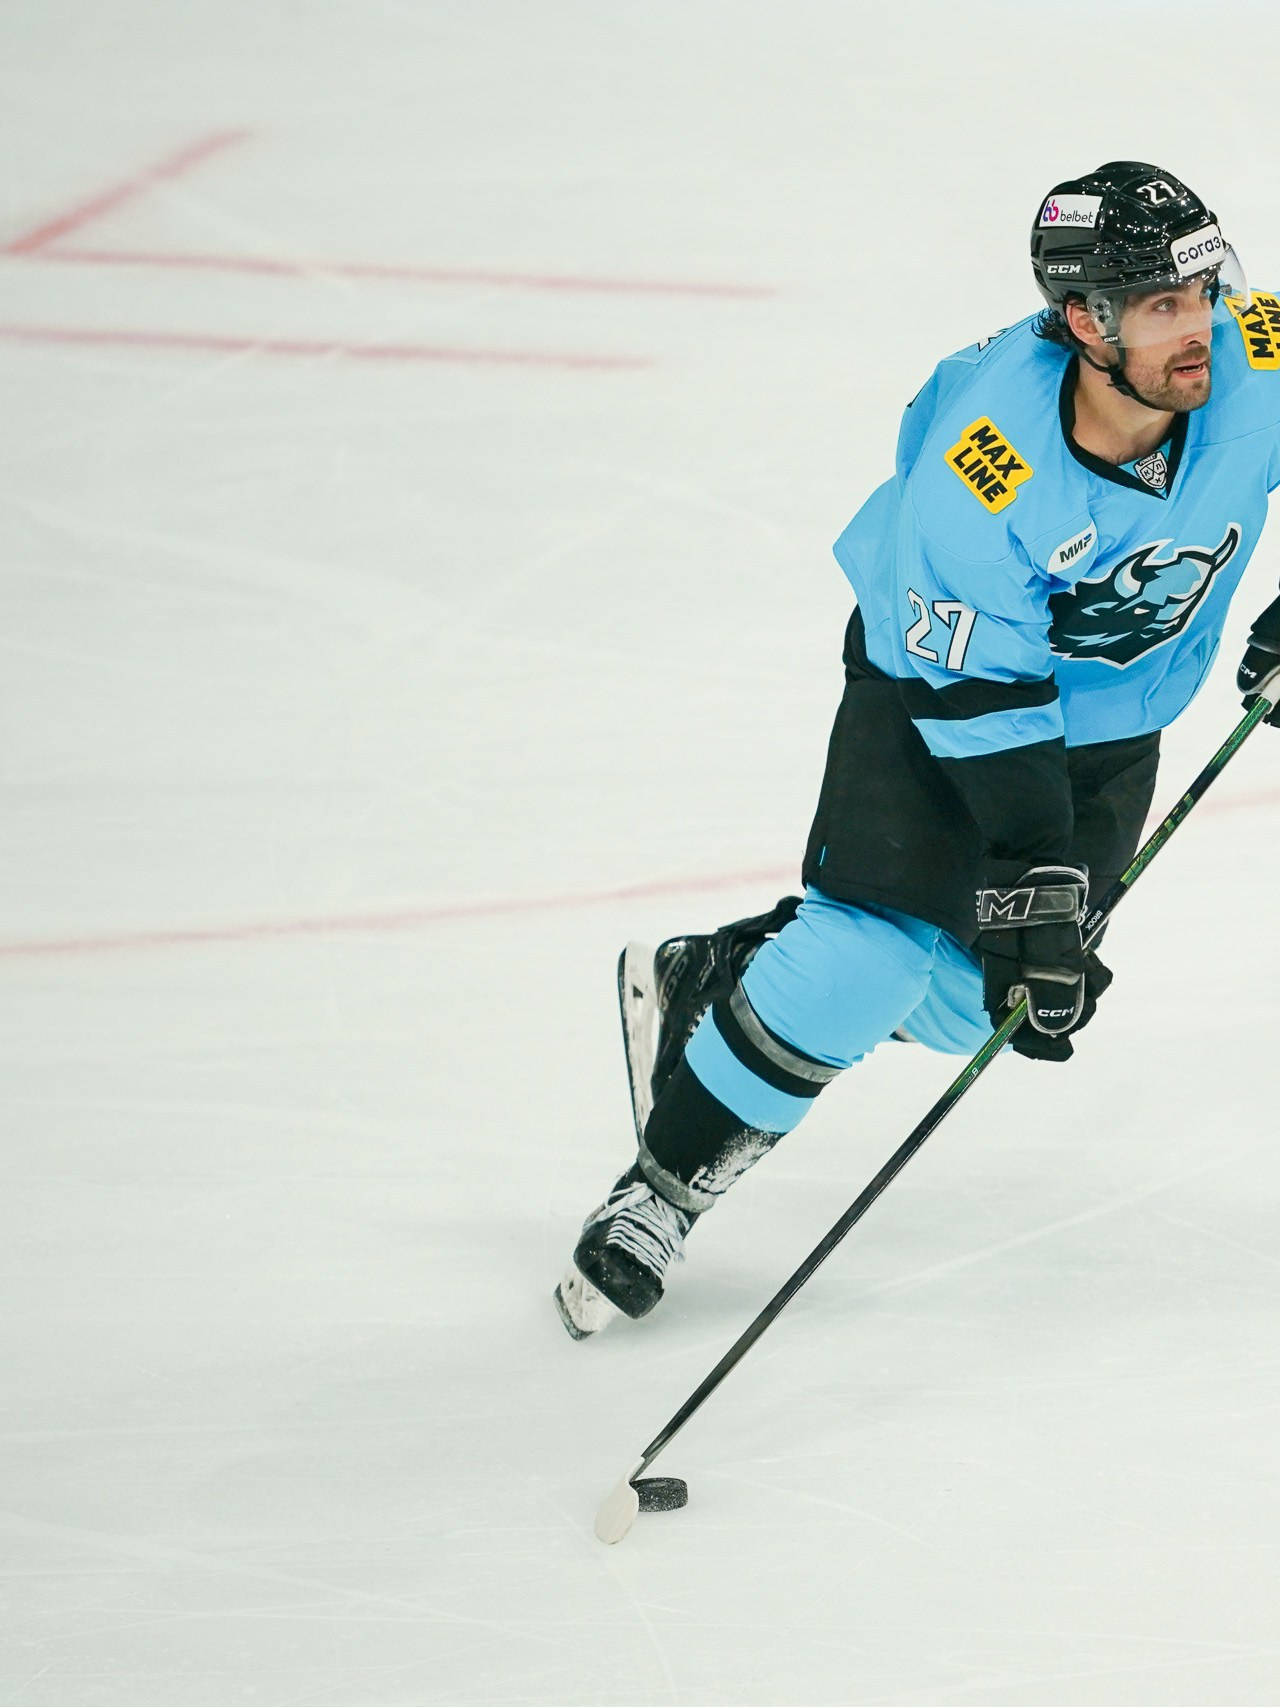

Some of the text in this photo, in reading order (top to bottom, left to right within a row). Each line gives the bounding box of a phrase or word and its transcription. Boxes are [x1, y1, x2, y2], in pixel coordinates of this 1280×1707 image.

[1136, 179, 1178, 206] 27
[1060, 210, 1094, 224] belbet
[1047, 264, 1082, 274] CCM
[969, 424, 1024, 480] MAX
[952, 446, 1008, 504] LINE
[1059, 533, 1092, 563] МИР
[906, 587, 978, 671] 27
[1037, 1006, 1075, 1018] CCM
